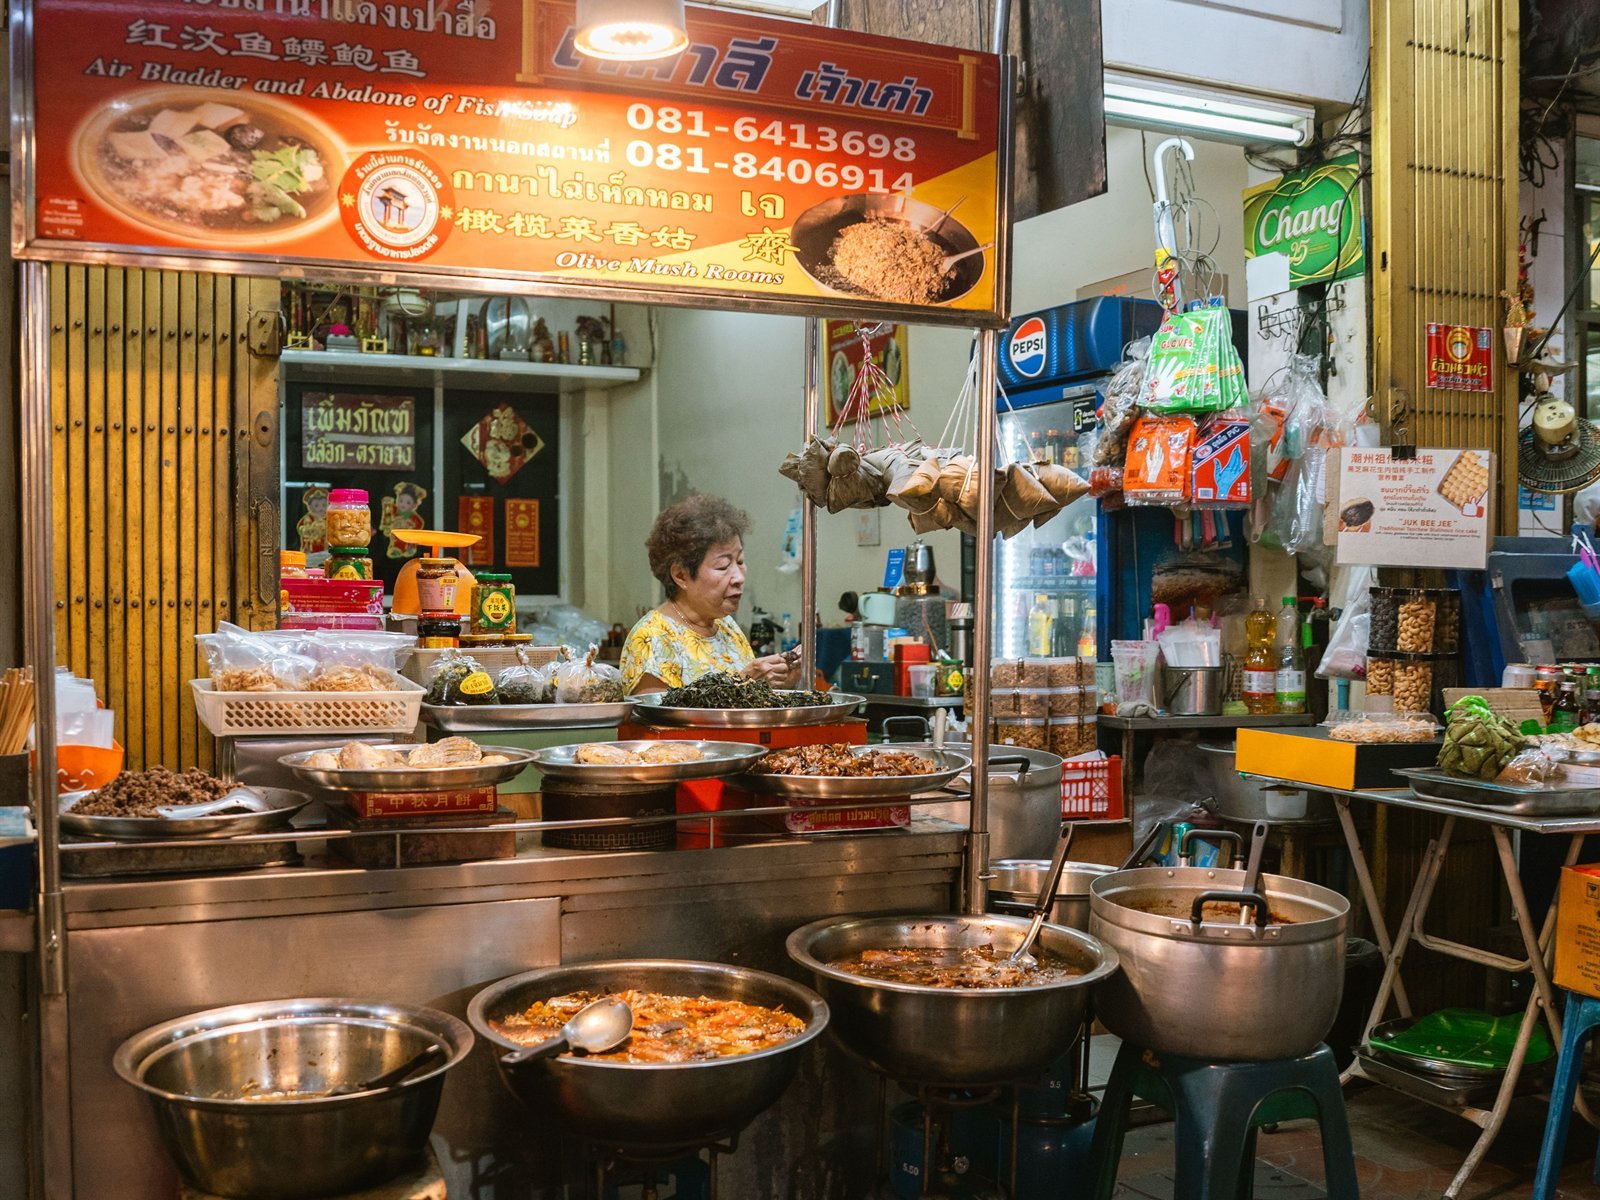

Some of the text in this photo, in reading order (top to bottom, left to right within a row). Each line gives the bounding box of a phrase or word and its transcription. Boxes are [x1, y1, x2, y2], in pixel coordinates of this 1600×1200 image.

[125, 18, 427, 79] 红汶鱼鳔鲍鱼
[85, 57, 134, 79] Air
[140, 61, 249, 91] Bladder
[254, 74, 304, 97] and
[312, 80, 416, 109] Abalone
[423, 94, 454, 115] of
[793, 62, 934, 117] เจ้าเก่า
[626, 102, 917, 163] 081-6413698
[625, 139, 915, 196] 081-8406914
[739, 189, 786, 220] เจ
[1258, 198, 1345, 248] Chang
[554, 250, 785, 286] Olive Mush Rooms
[1012, 337, 1044, 356] PEPSI
[1160, 338, 1194, 349] GLOVES
[1420, 519, 1435, 527] BEE
